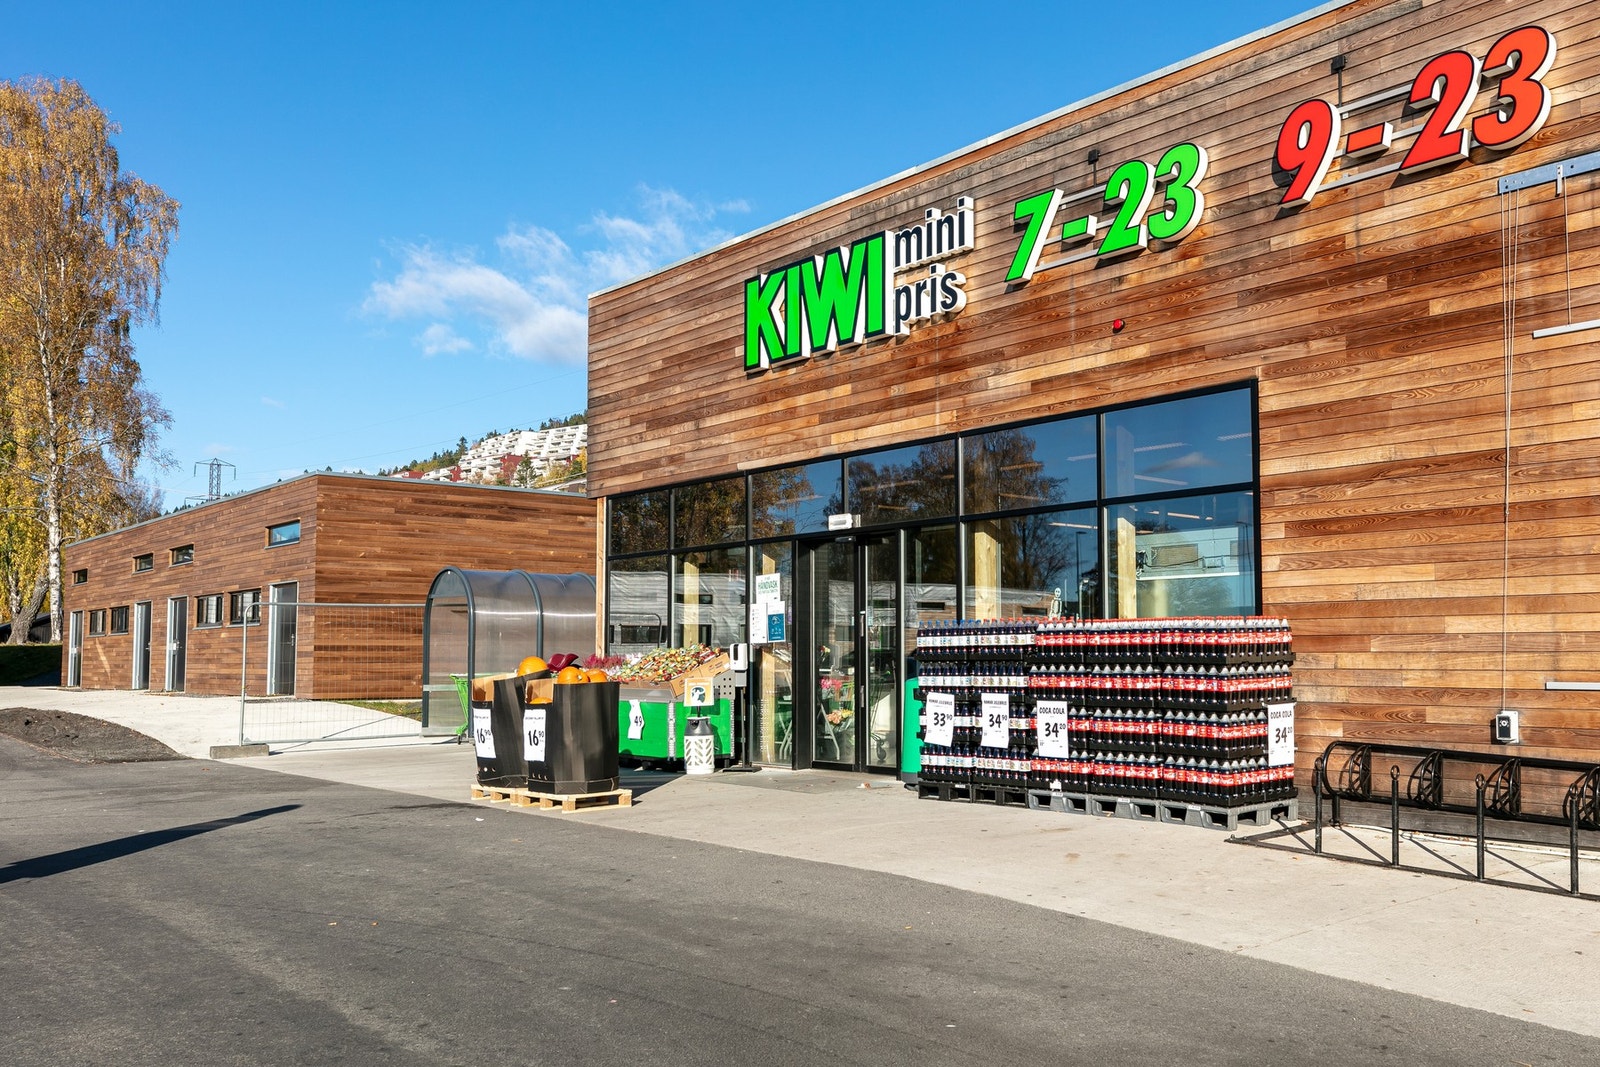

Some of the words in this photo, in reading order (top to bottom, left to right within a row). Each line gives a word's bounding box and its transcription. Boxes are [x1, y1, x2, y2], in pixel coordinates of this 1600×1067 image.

[895, 197, 968, 269] mini
[744, 230, 888, 372] KIWI
[895, 264, 961, 335] pris
[634, 715, 642, 727] 49
[1270, 711, 1281, 719] COCA
[1282, 710, 1292, 718] COLA
